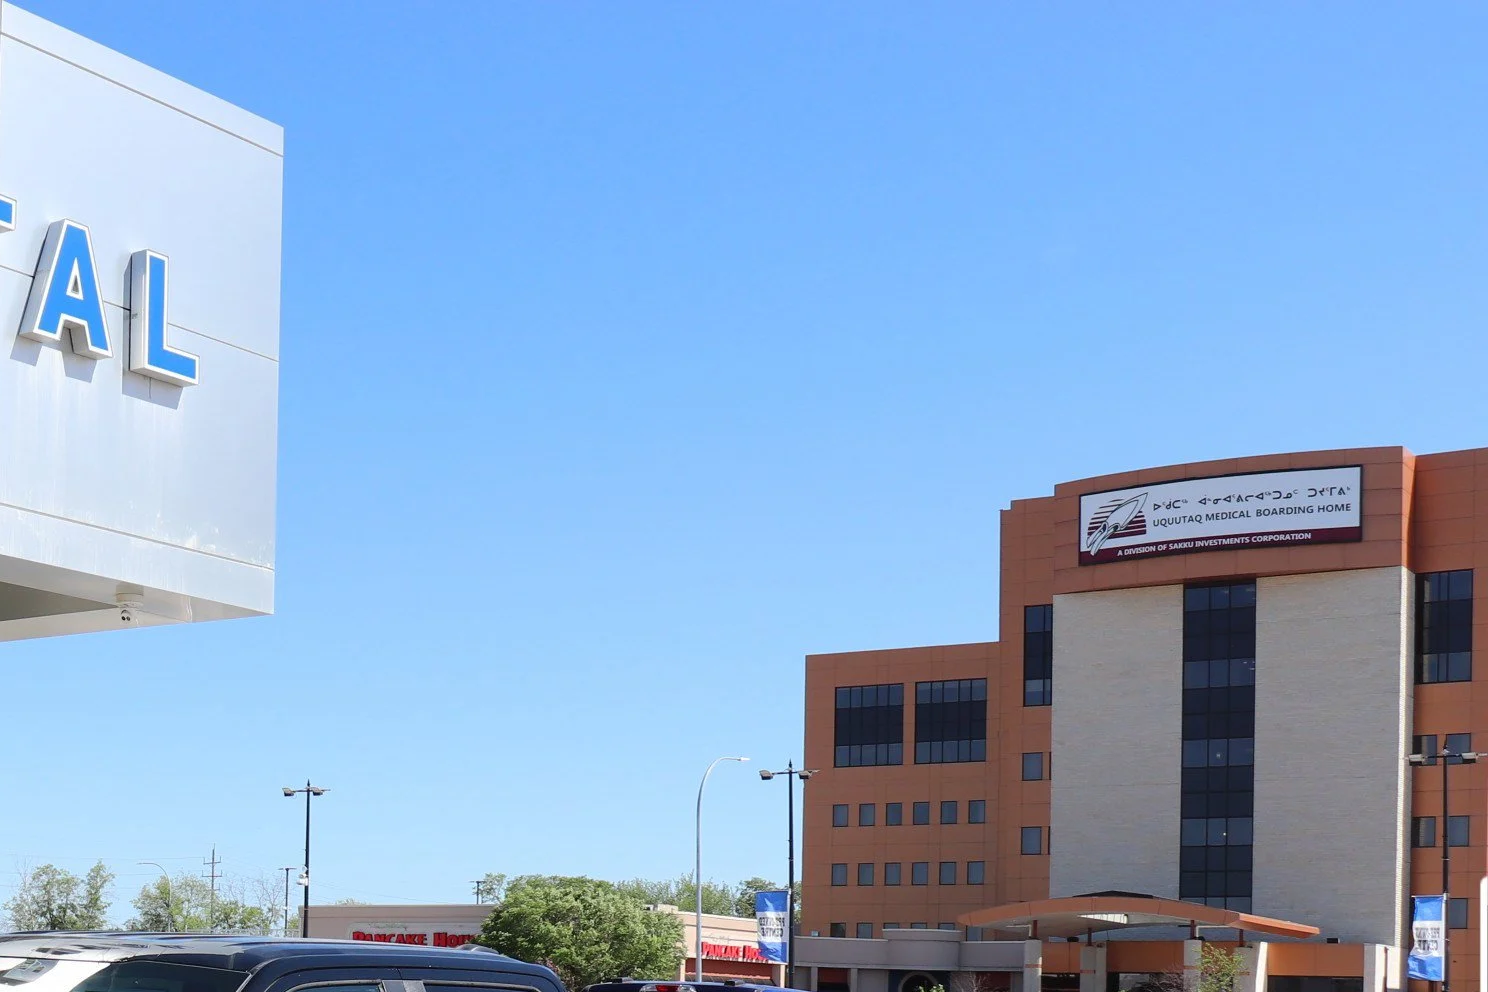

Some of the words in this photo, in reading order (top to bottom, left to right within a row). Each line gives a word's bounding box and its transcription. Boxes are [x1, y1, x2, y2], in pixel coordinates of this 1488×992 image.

[1153, 514, 1202, 528] UQUUTAQ
[1205, 510, 1251, 522] MEDICAL
[1256, 505, 1314, 517] BOARDING
[1317, 503, 1351, 513] HOME
[1124, 545, 1156, 556] DIVISION
[1168, 541, 1194, 550] SAKKU
[1195, 536, 1250, 548] INVESTMENTS
[1251, 532, 1312, 543] CORPORATION
[352, 931, 428, 946] PANCAKE
[701, 942, 743, 959] PANCAKE
